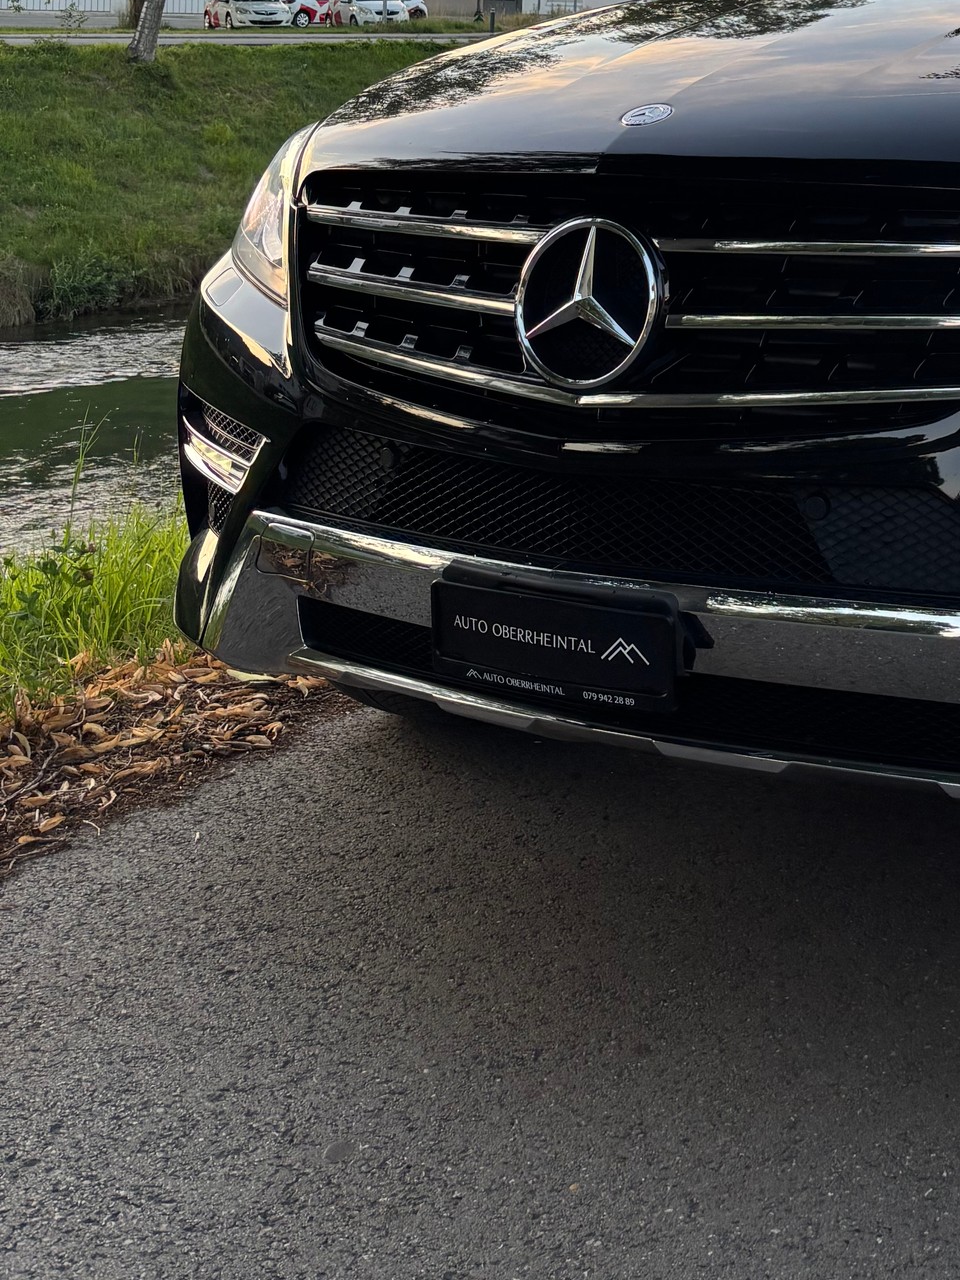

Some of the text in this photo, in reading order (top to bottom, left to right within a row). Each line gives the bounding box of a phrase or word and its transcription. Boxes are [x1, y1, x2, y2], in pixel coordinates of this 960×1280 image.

[454, 614, 596, 654] AUTO OBERRHEINTAL
[482, 672, 565, 696] AUTO OBERRHEINTAL
[582, 691, 635, 706] 079 942 28 89
